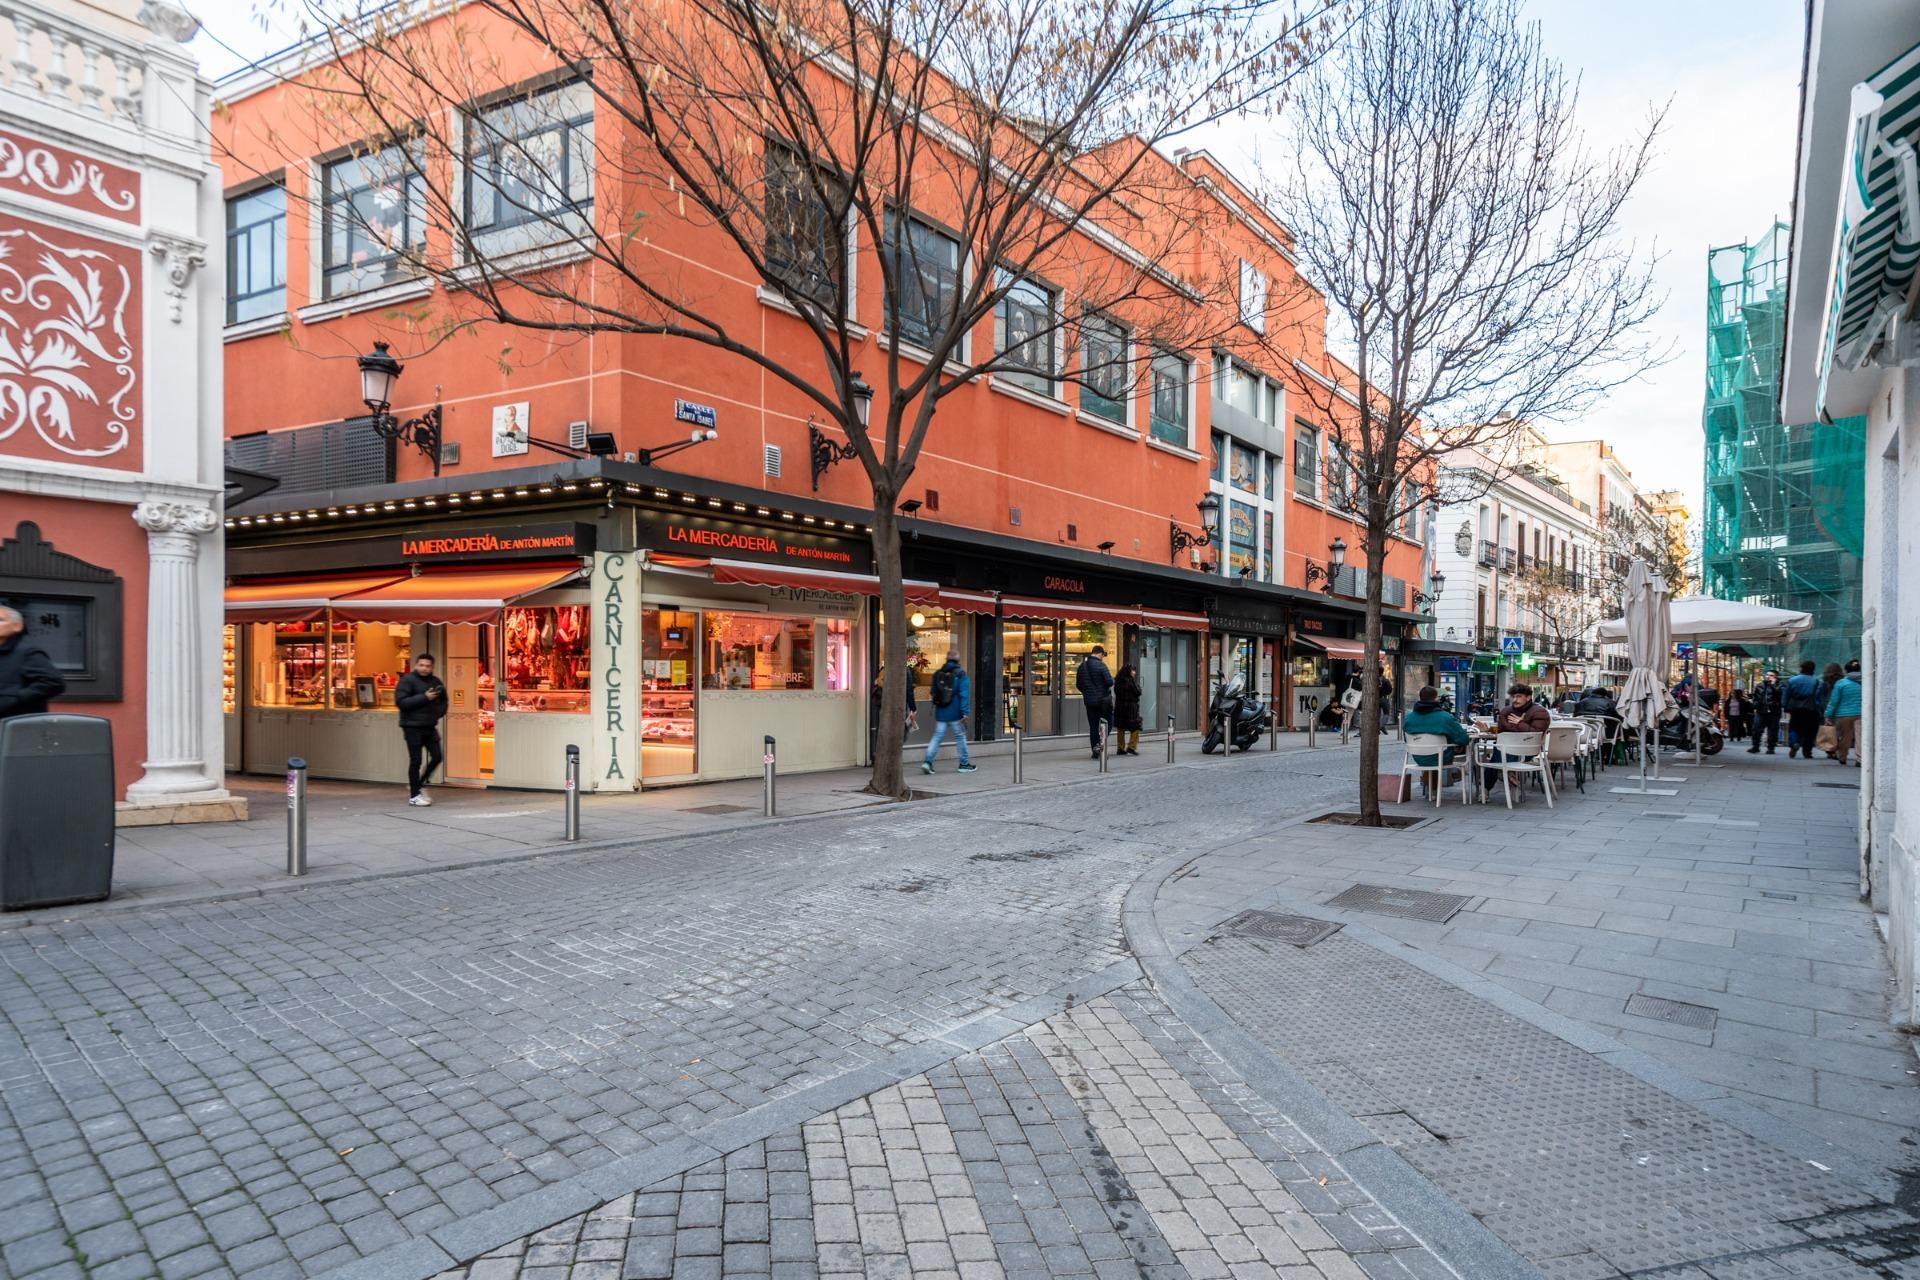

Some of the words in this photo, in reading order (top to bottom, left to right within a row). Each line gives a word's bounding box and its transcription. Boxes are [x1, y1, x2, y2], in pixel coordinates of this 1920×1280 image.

[679, 410, 697, 422] SANTA
[697, 416, 715, 427] ISABEL
[402, 541, 418, 555] LA
[418, 533, 499, 554] MERCADERÍA
[500, 540, 512, 550] DE
[512, 537, 541, 549] ANTÓN
[541, 535, 574, 548] MARTÍN
[668, 526, 688, 542] LA
[689, 528, 778, 553] MERCADERÍA
[786, 546, 797, 556] DE
[797, 547, 823, 559] ANTÓN
[823, 551, 850, 562] MARTÍN
[1044, 575, 1085, 593] CARACOLA
[1299, 694, 1319, 713] TKO
